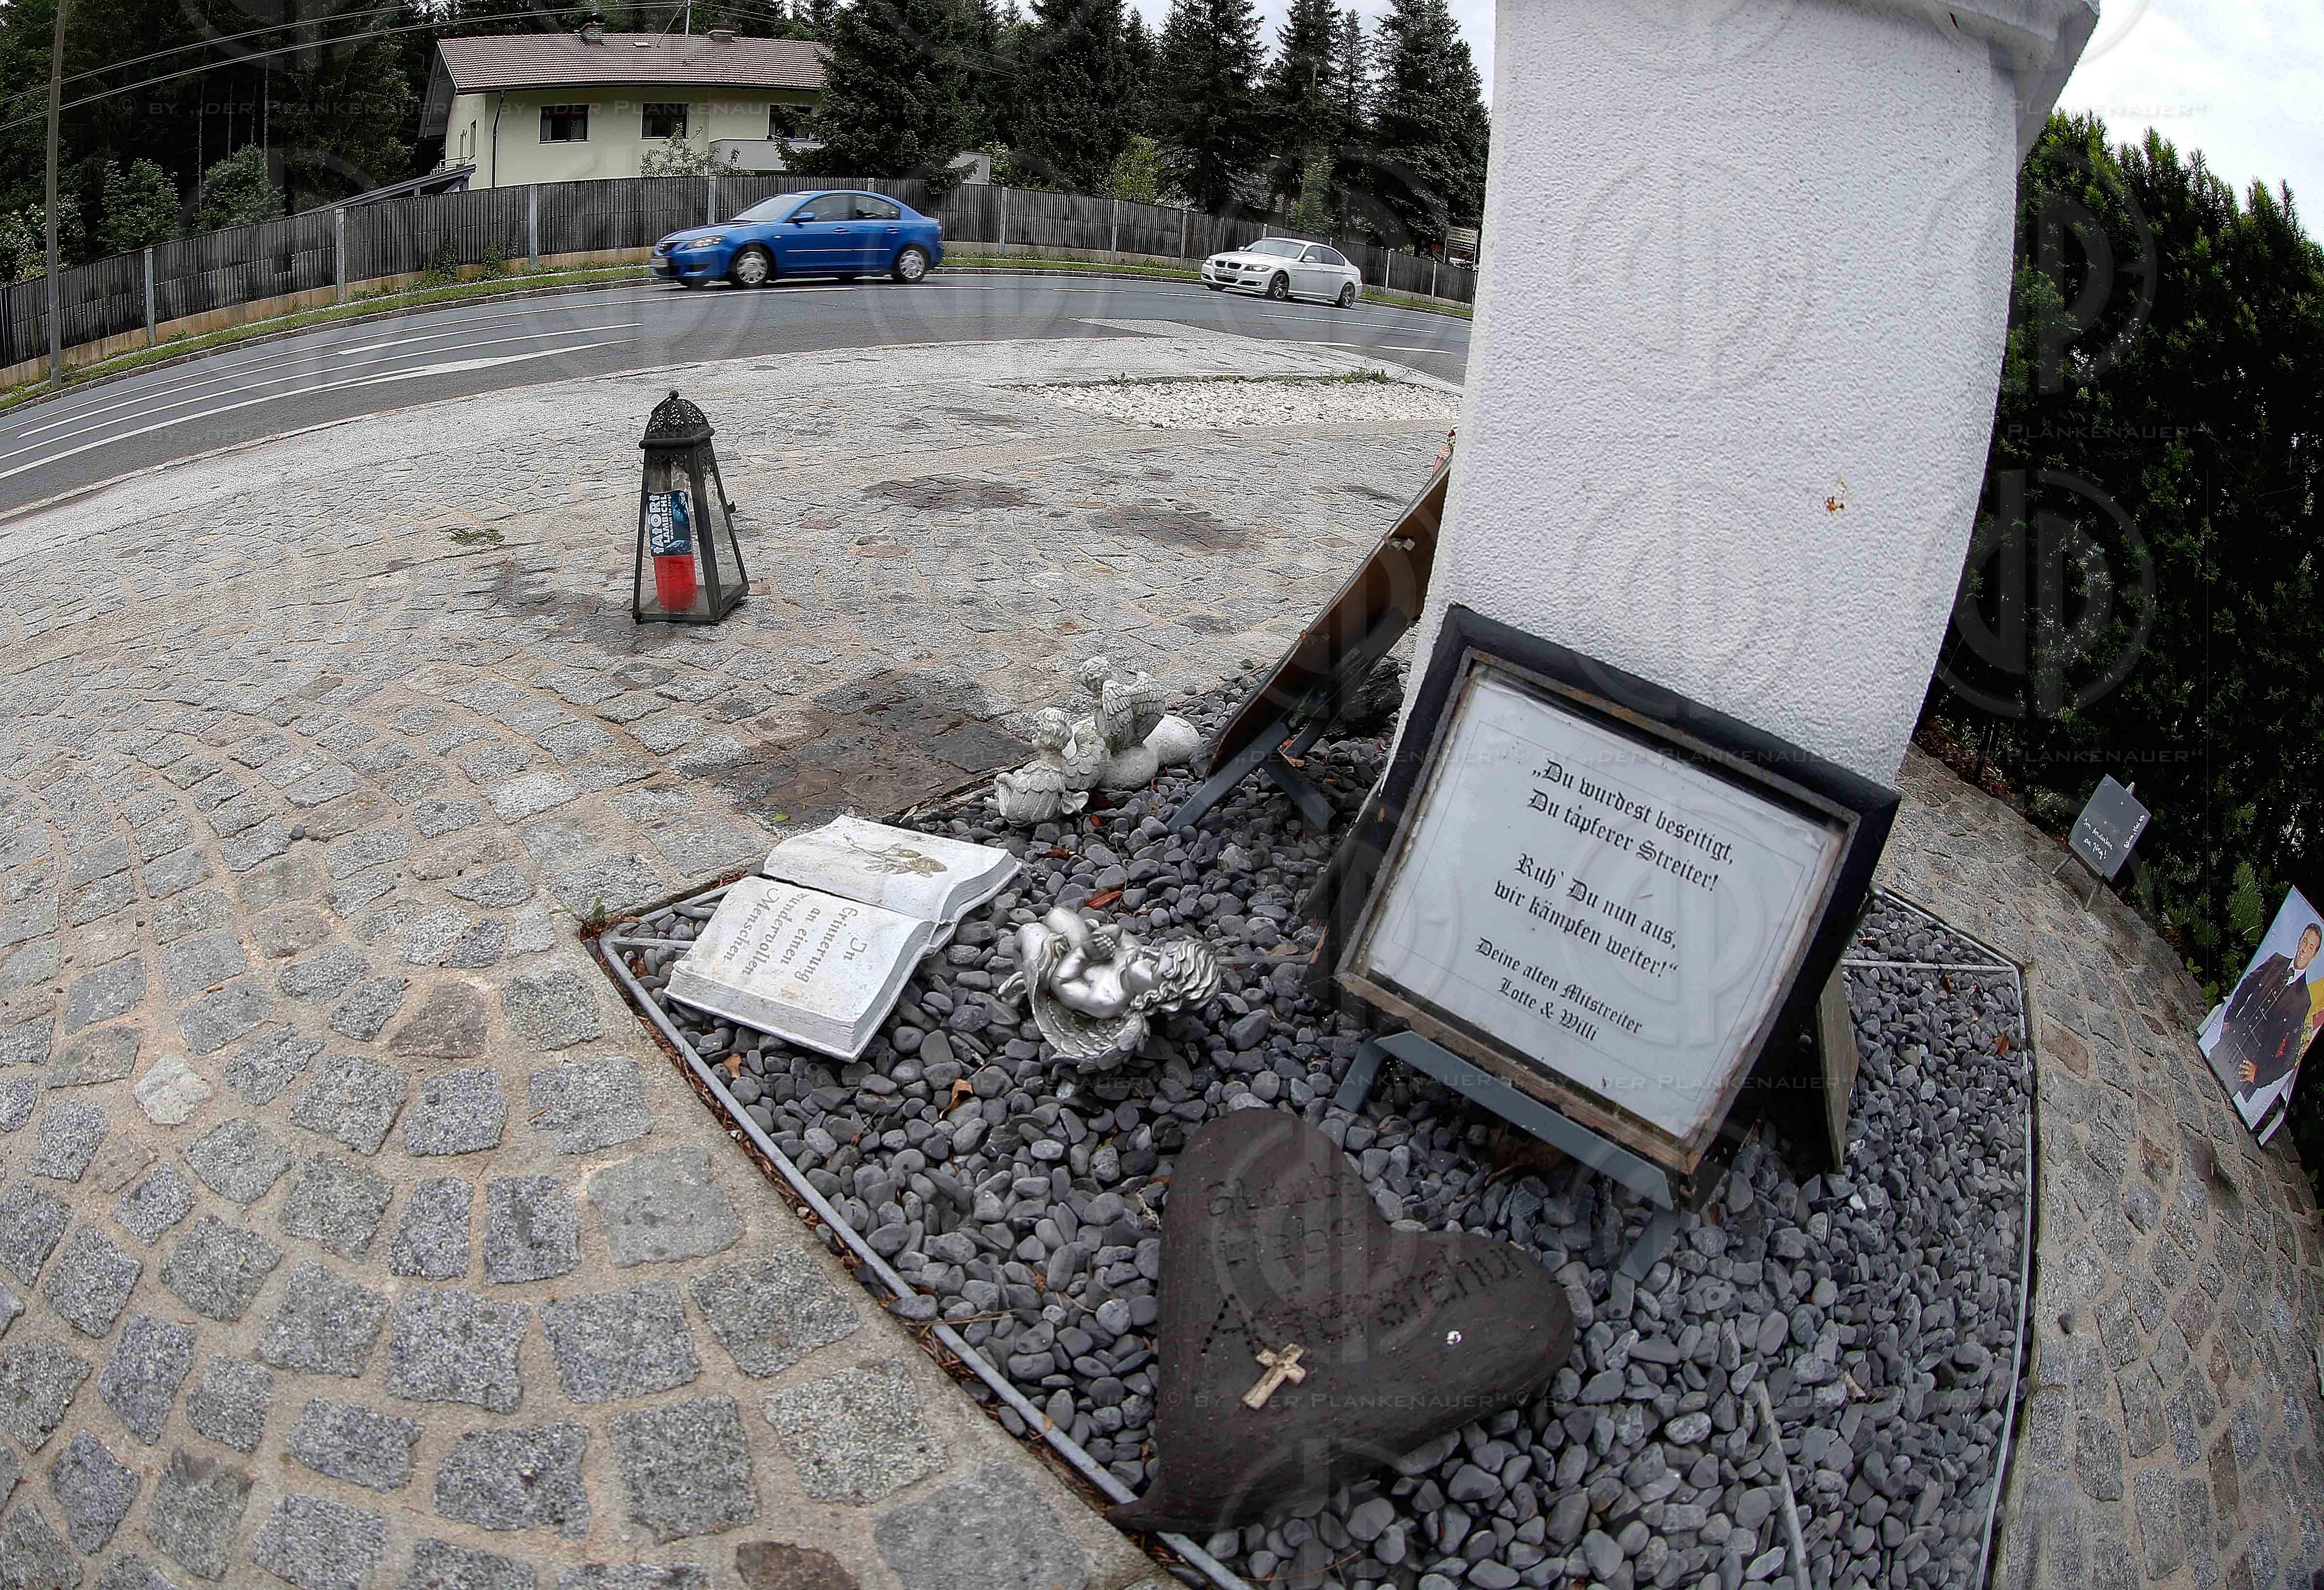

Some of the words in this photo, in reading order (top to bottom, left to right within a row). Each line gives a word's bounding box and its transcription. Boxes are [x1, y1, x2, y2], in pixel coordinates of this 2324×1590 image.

[661, 494, 670, 543] LAMBICHL
[1527, 788, 1560, 818] Du
[1563, 805, 1635, 852] tapferer
[1636, 839, 1720, 892] Streiter!
[1578, 775, 1652, 823] wurdest
[1656, 806, 1735, 865] beseitigt,
[2083, 818, 2091, 830] Im
[723, 887, 780, 962] Menschen
[742, 893, 809, 976] wundervollen
[780, 928, 808, 965] einen
[794, 907, 859, 983] Erinnerung
[805, 907, 821, 923] an
[1494, 880, 1525, 907] wir
[1528, 898, 1601, 946] kämpfen
[1566, 878, 1599, 909] Du
[1602, 901, 1638, 927] nun
[1641, 918, 1677, 950] aus,
[843, 936, 867, 961] In
[1476, 937, 1521, 972] Deine
[1523, 963, 1559, 992] alten
[1560, 983, 1643, 1034] Mitstreiter
[1498, 977, 1537, 1010] Lotte
[1540, 1001, 1554, 1018] &
[1559, 1007, 1600, 1042] Willi
